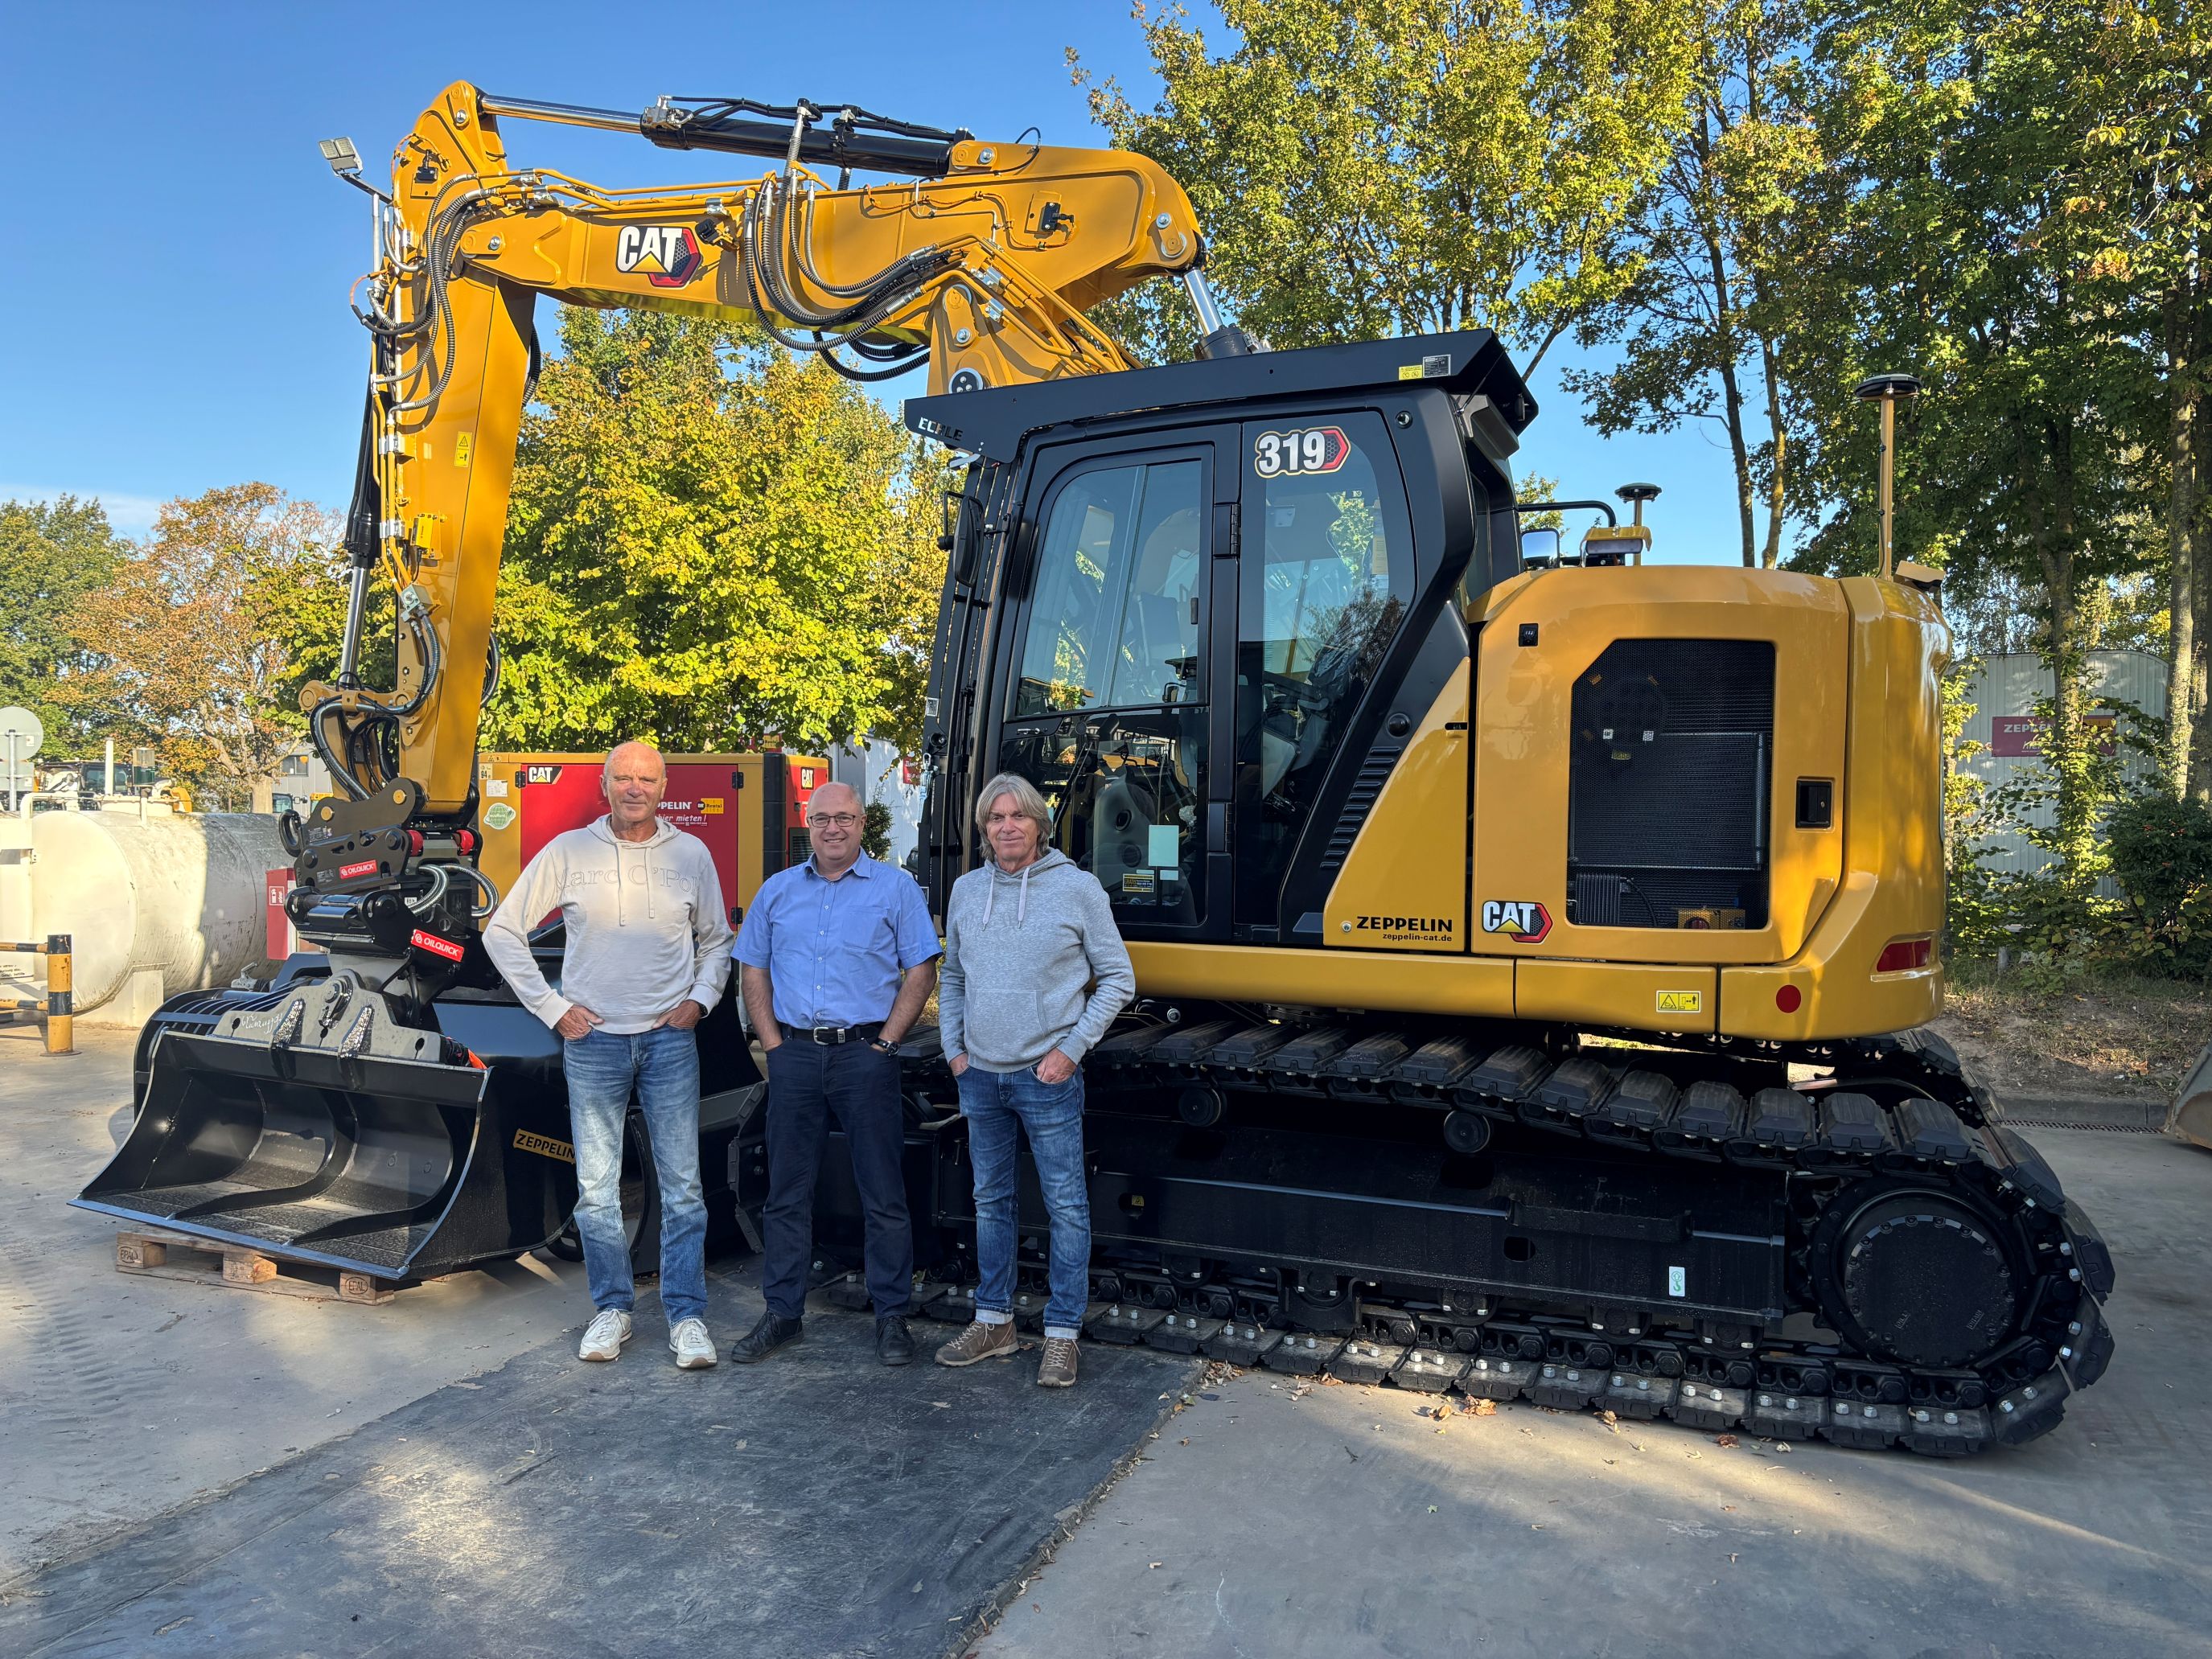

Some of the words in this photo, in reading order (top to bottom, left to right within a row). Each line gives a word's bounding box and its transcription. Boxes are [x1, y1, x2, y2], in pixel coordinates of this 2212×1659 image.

[618, 226, 683, 273] CAT
[919, 417, 964, 441] ECHLE
[1259, 431, 1326, 473] 319
[528, 766, 553, 783] CAT
[801, 768, 814, 788] CAT
[347, 864, 373, 874] OILQUICK
[1356, 916, 1452, 932] ZEPPELIN
[1483, 901, 1536, 933] CAT
[424, 938, 458, 956] OILQUICK
[1383, 934, 1452, 942] zeppelin-cat.de
[516, 1134, 575, 1159] ZEPPELIN
